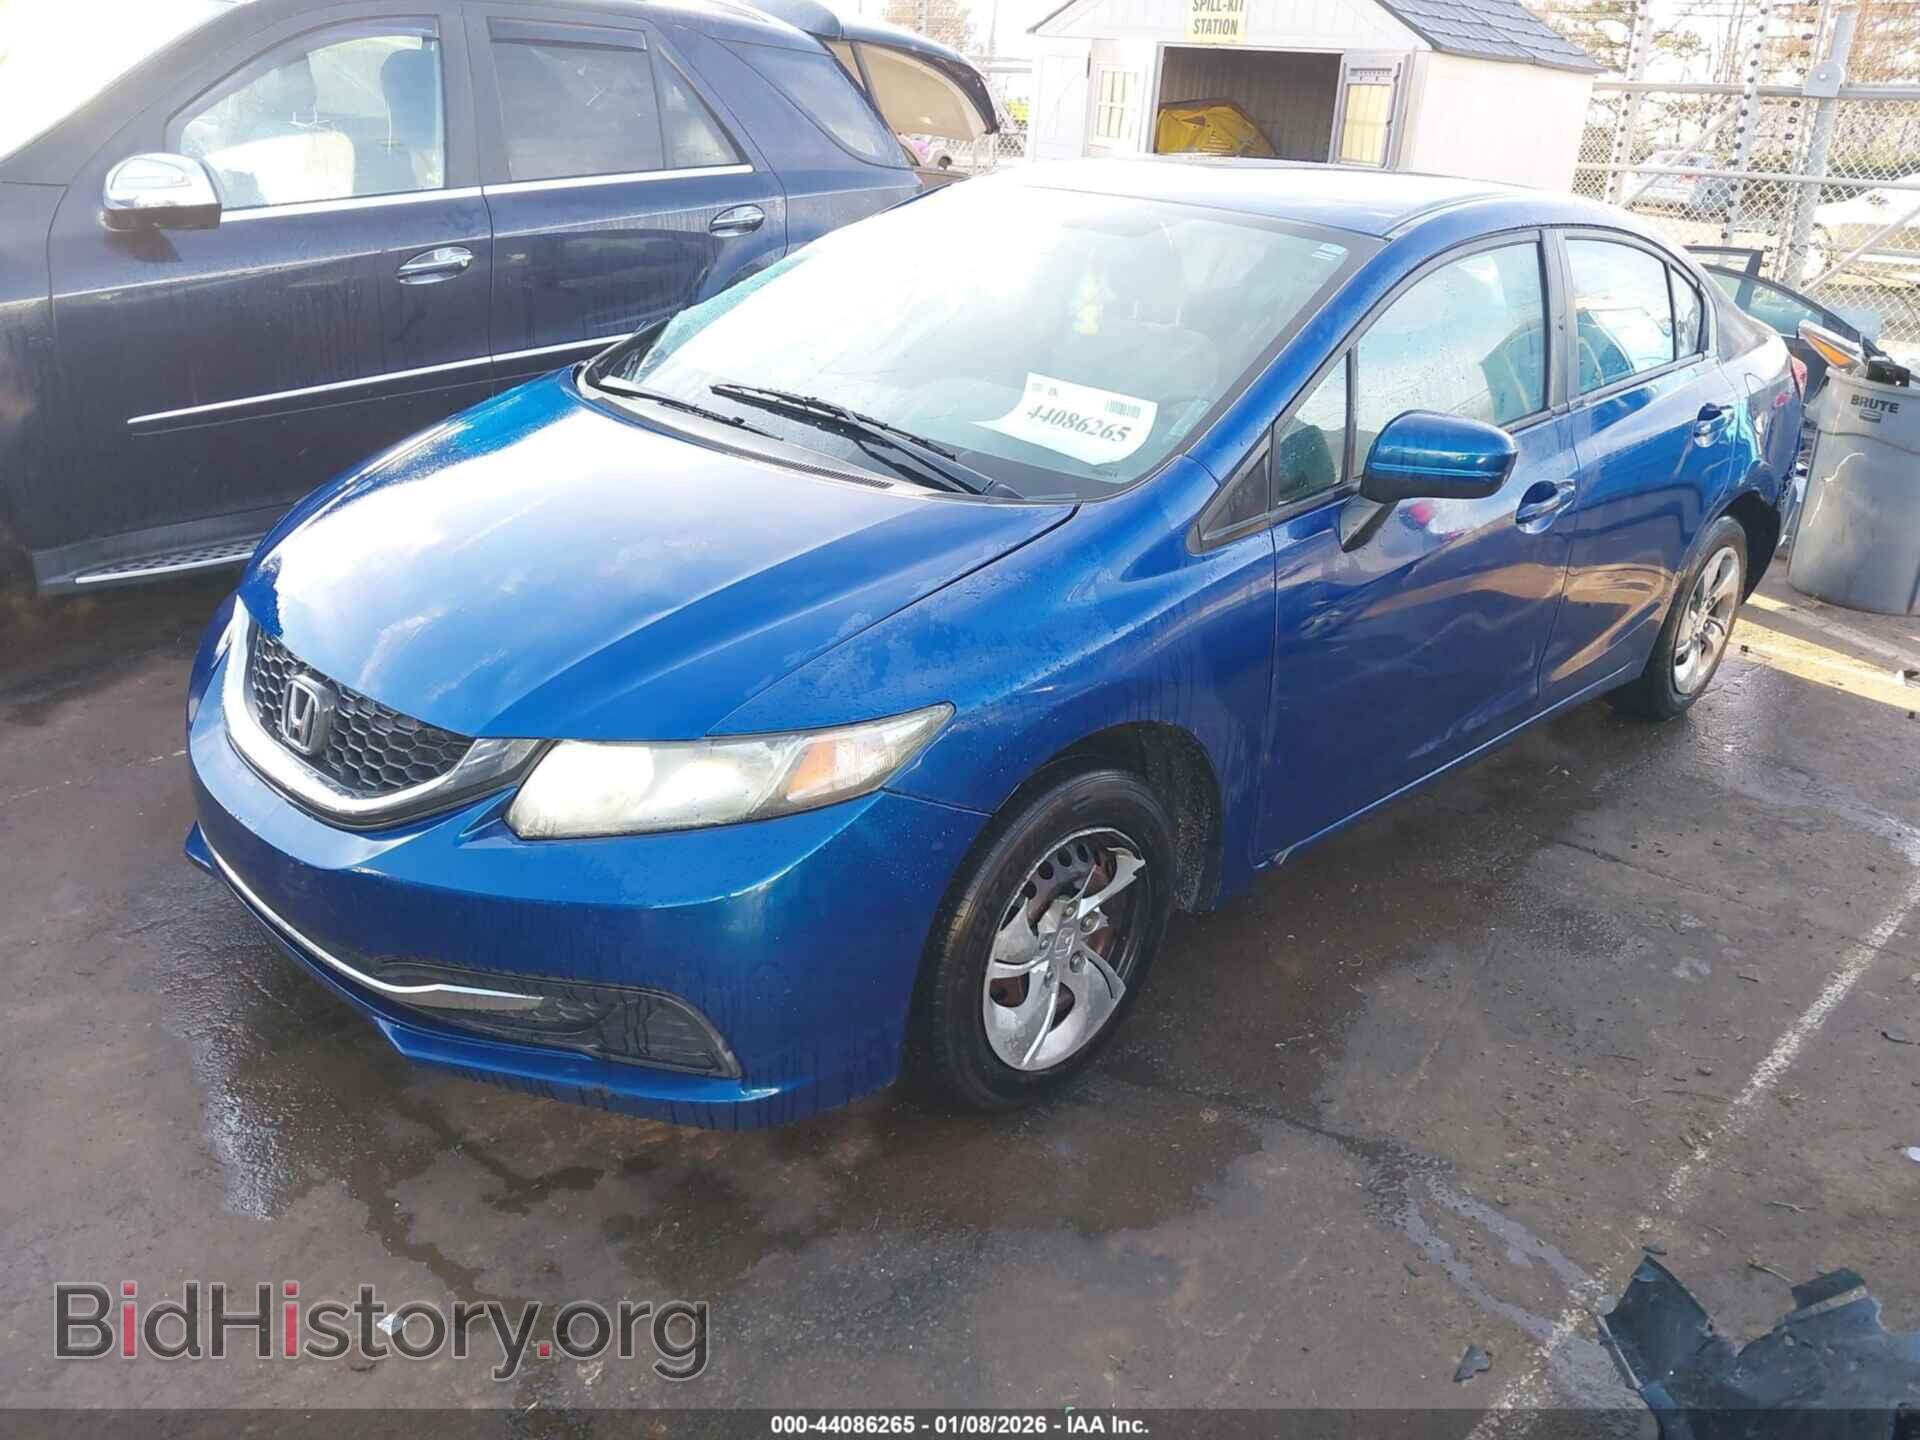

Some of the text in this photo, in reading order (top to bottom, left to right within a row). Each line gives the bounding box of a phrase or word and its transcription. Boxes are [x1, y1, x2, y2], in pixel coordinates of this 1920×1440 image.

[1192, 0, 1244, 12] SPILL-KIT
[1193, 18, 1239, 35] STATION
[1850, 394, 1900, 414] BRUTE
[1027, 404, 1132, 442] 44086265
